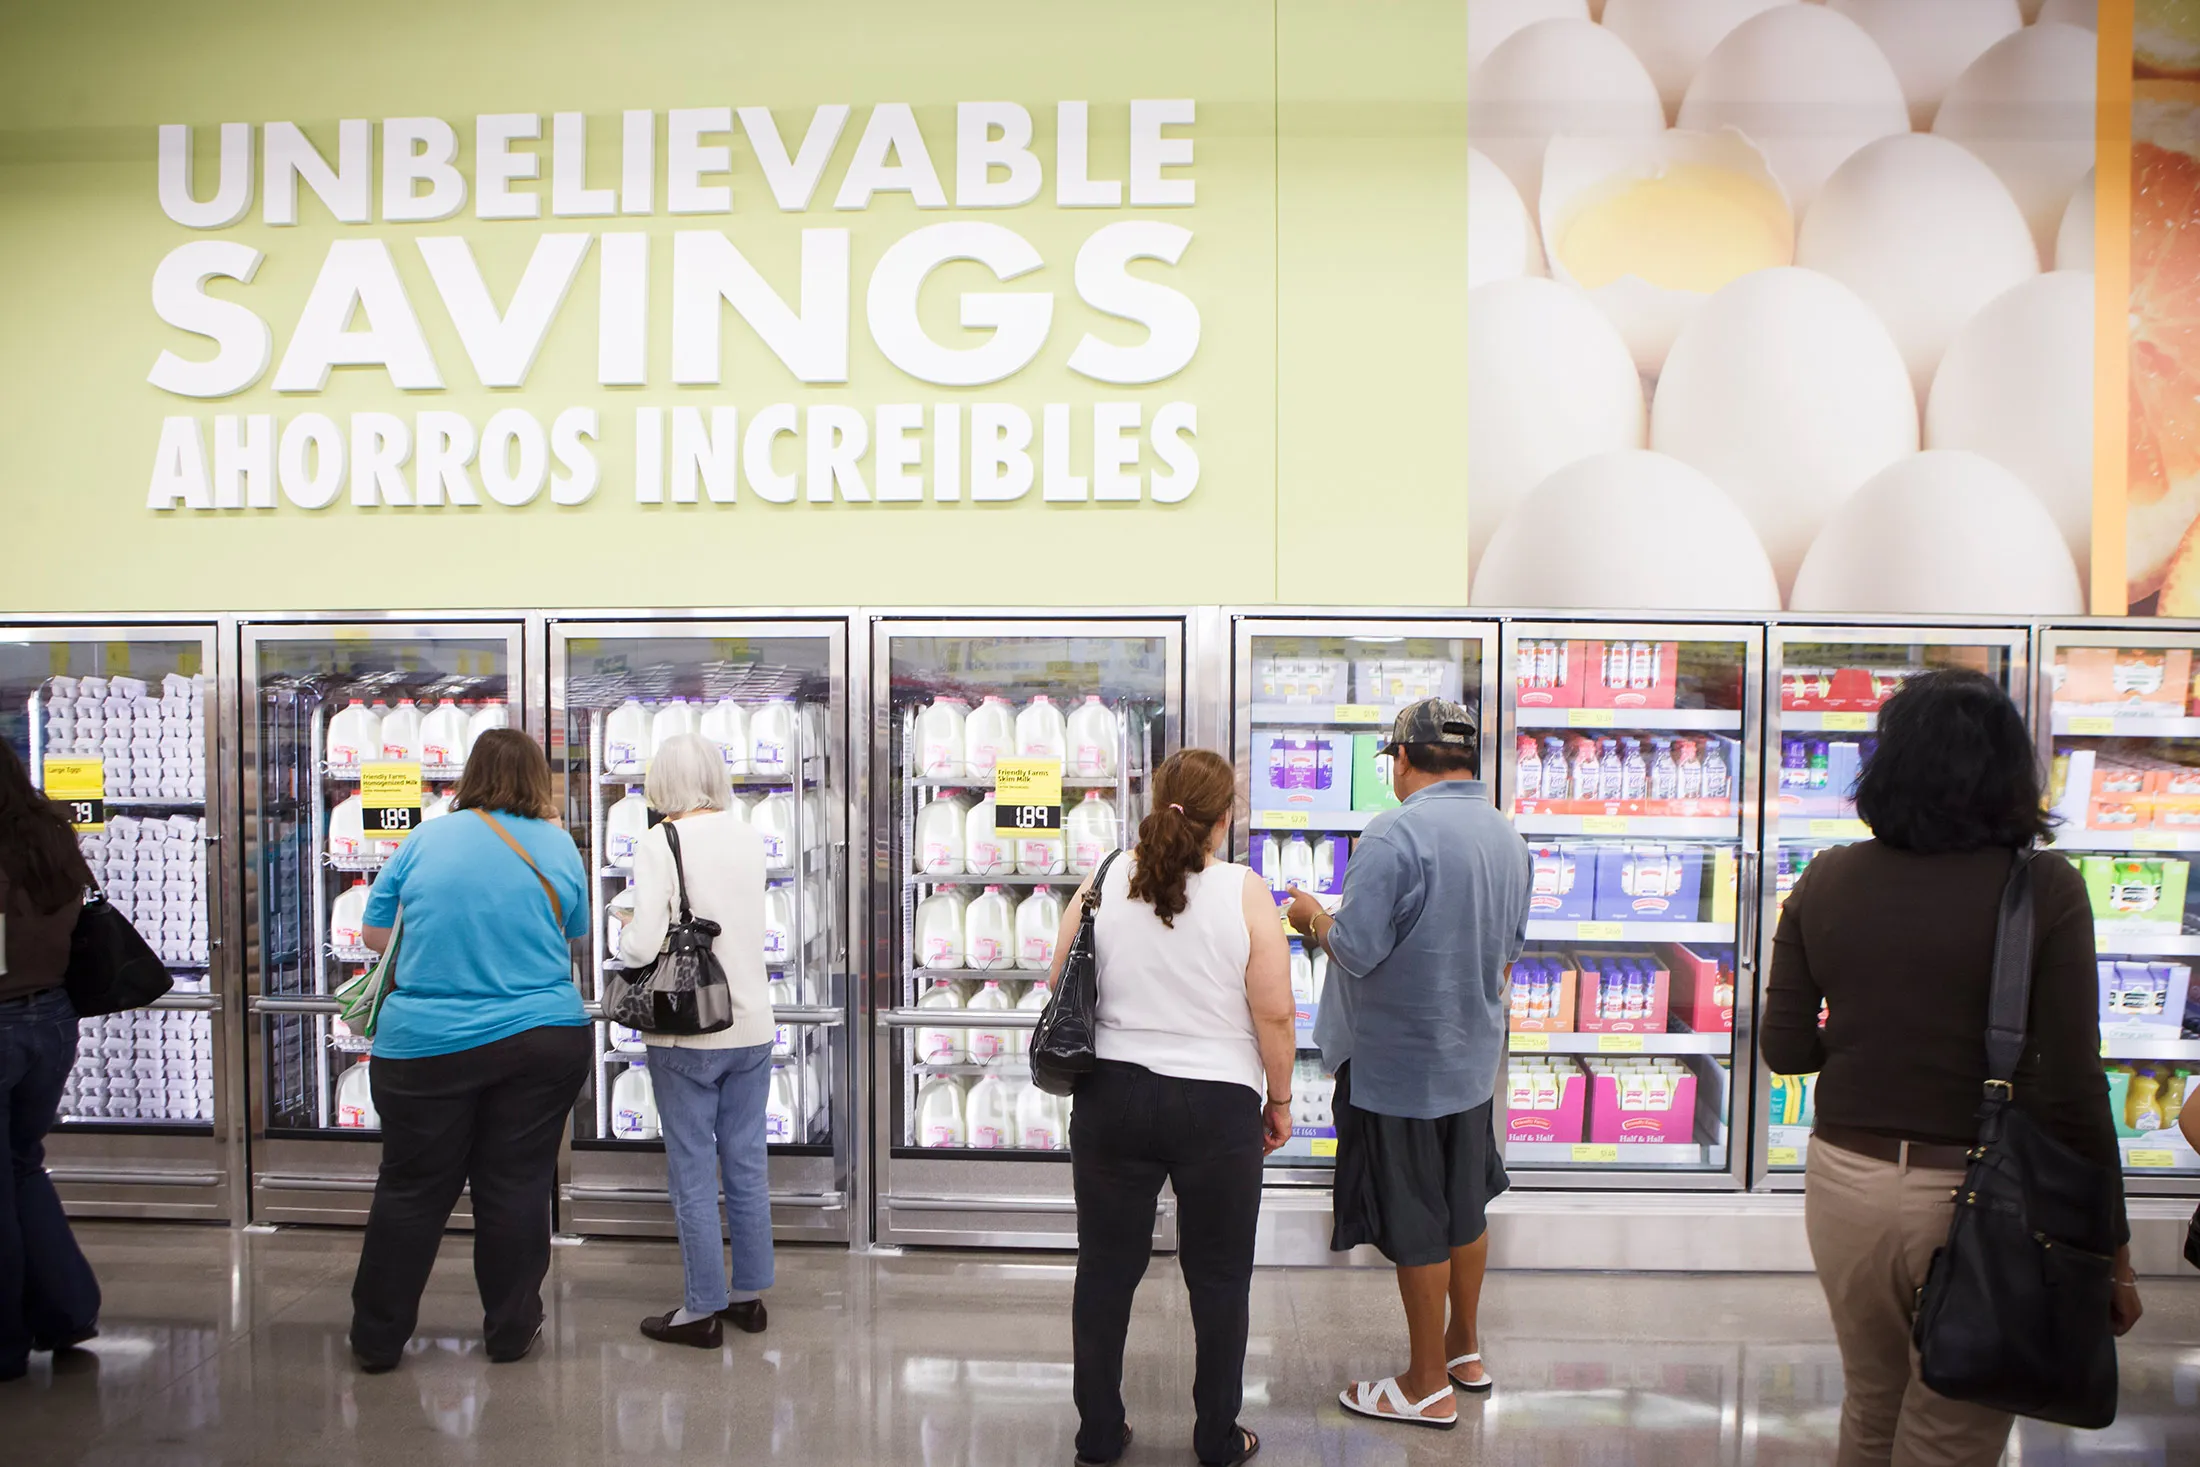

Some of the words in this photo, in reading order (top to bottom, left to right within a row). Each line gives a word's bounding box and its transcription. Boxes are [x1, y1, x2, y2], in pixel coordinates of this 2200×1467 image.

[157, 98, 1196, 231] UNBELIEVABLE
[146, 220, 1201, 397] SAVINGS
[146, 404, 600, 510] AHORROS
[635, 401, 1201, 505] INCREIBLES
[66, 766, 82, 774] Eggs
[998, 769, 1026, 777] Friendly
[380, 808, 411, 829] 1.89
[1016, 806, 1048, 828] 1.89
[1508, 1133, 1528, 1141] Half
[1535, 1134, 1555, 1142] Half
[1619, 1134, 1638, 1142] Half
[1645, 1135, 1666, 1143] Half
